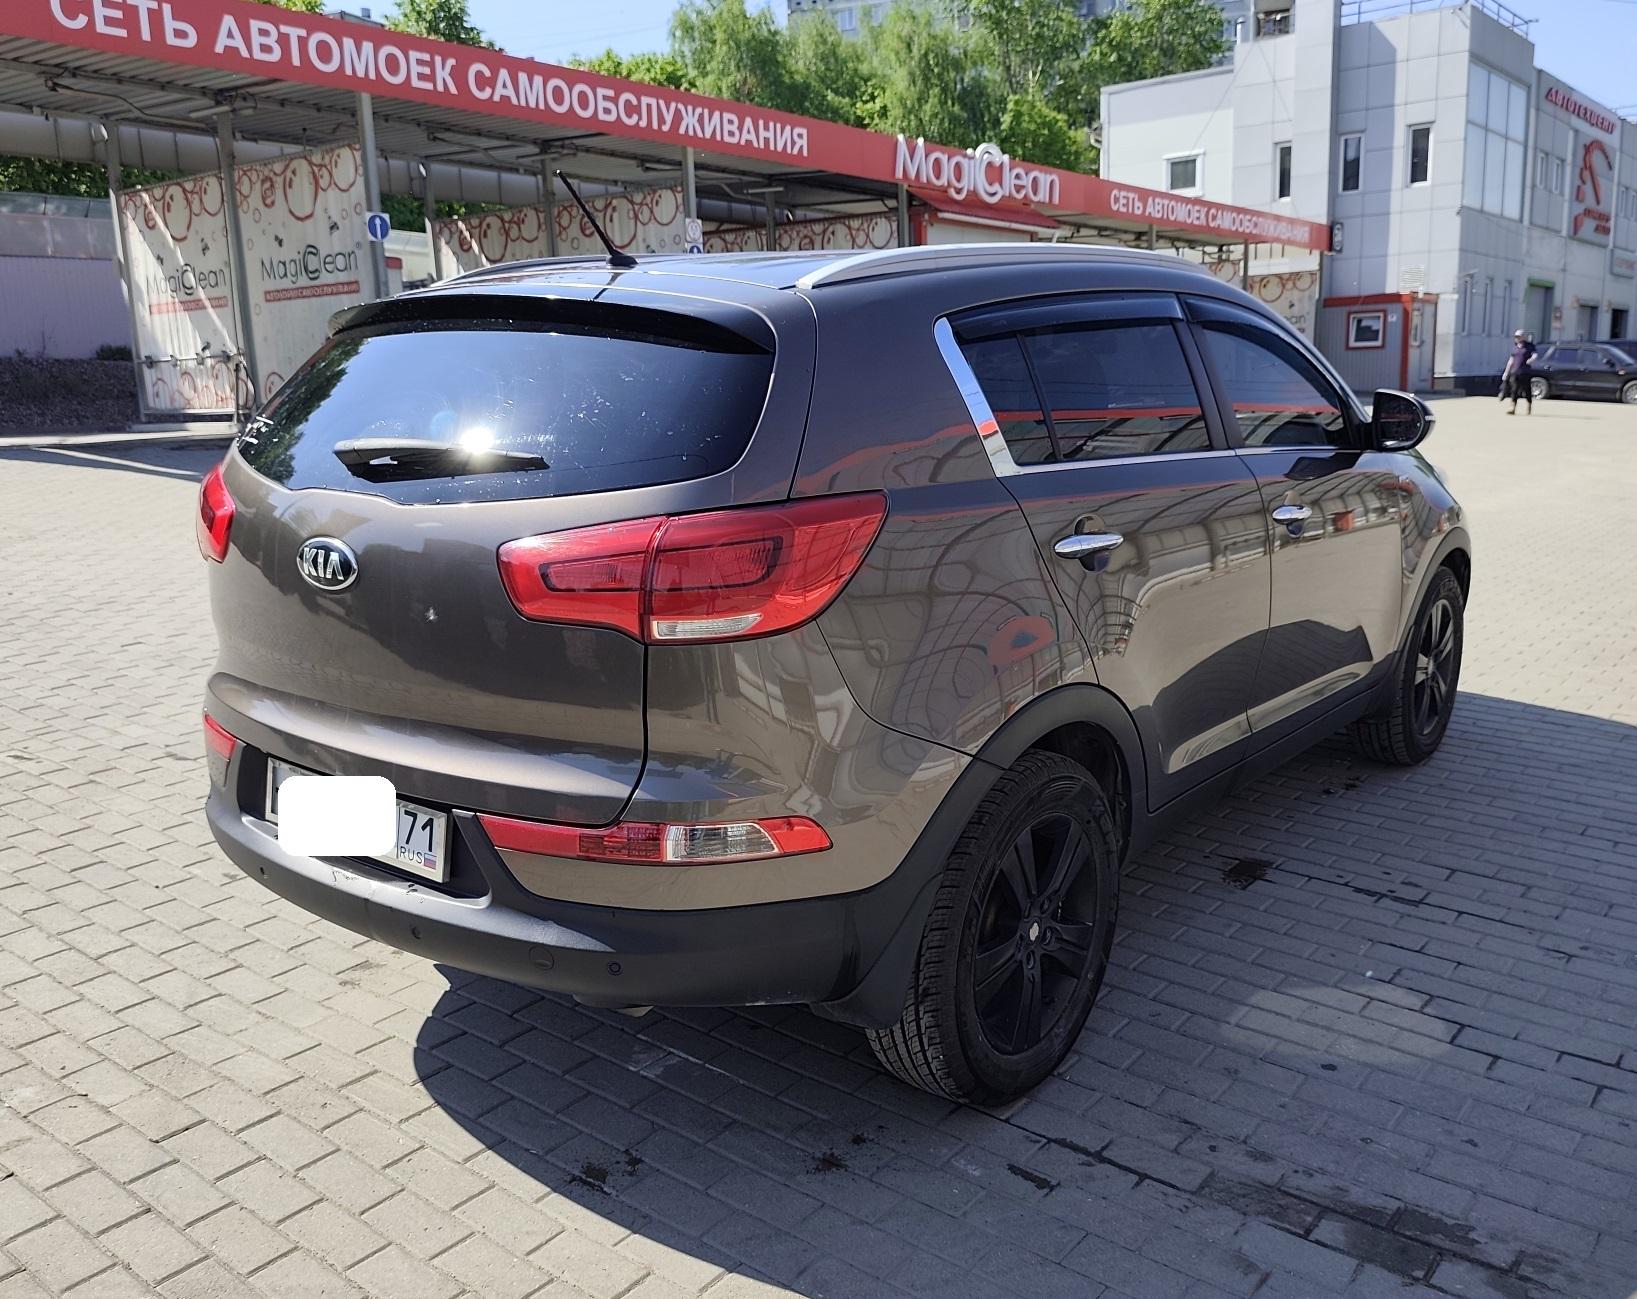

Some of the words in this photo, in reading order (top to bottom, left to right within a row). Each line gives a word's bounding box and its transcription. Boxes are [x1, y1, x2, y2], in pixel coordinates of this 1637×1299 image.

[51, 0, 198, 48] СЕТЬ
[214, 13, 459, 95] АВТОМОЕК
[467, 61, 808, 156] САМООБСЛУЖИВАНИЯ
[894, 133, 1060, 204] MagiClean
[1110, 189, 1143, 216] СЕТЬ
[1145, 196, 1208, 226] АВТОМОЕК
[260, 244, 359, 284] MagiClean
[302, 547, 345, 580] KIA
[403, 809, 435, 852] 71
[399, 845, 423, 864] RUS
